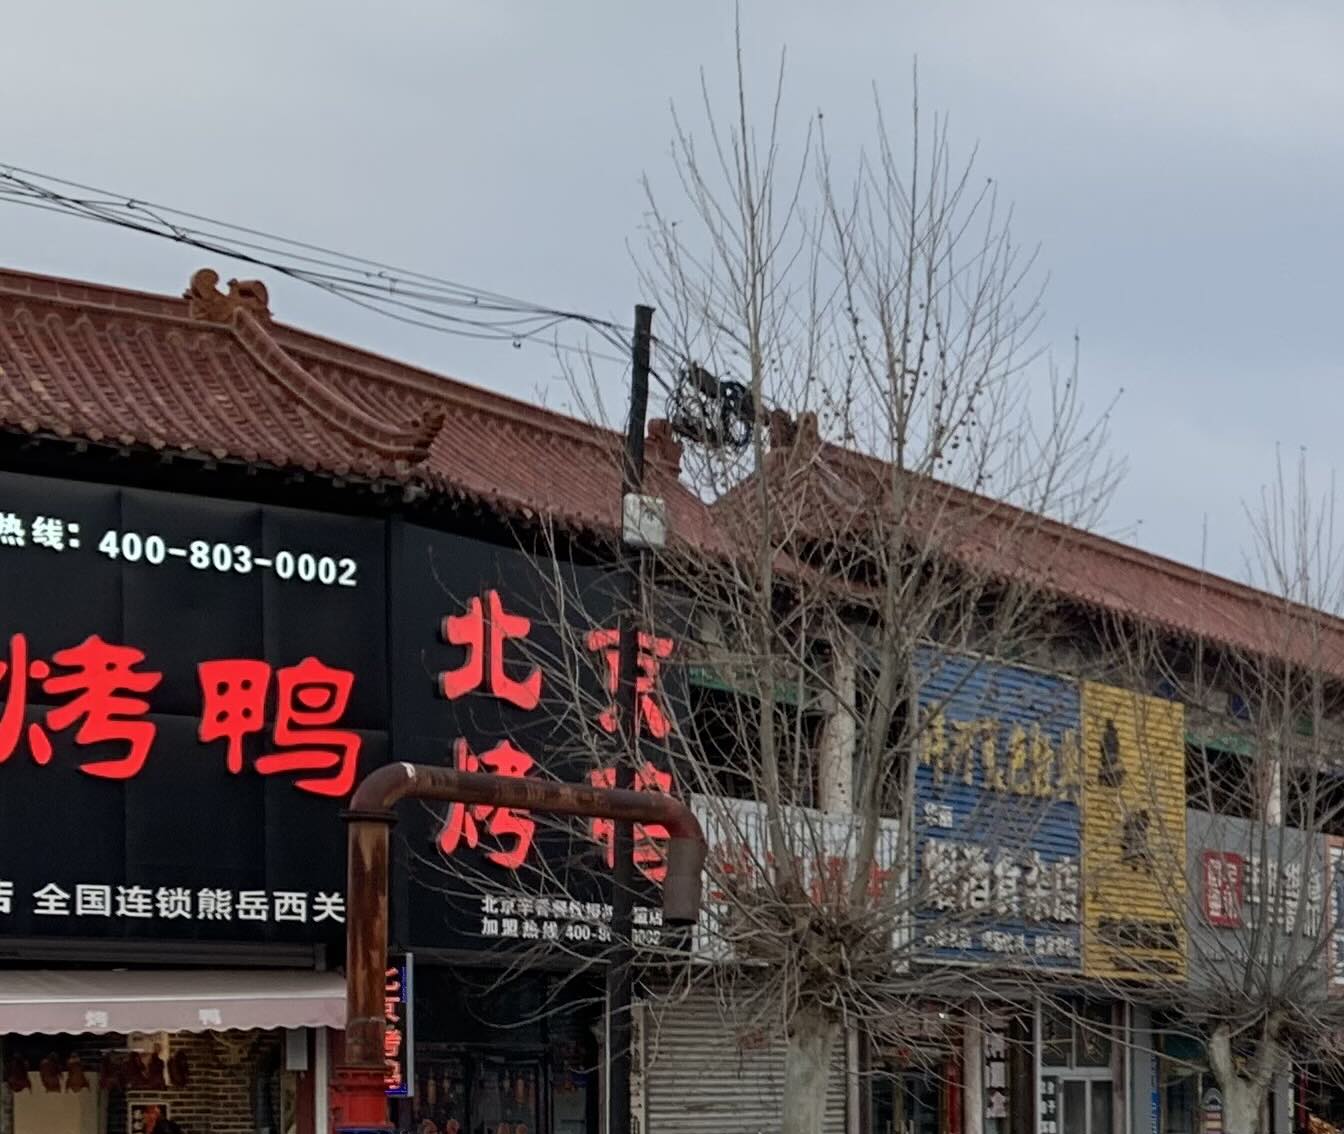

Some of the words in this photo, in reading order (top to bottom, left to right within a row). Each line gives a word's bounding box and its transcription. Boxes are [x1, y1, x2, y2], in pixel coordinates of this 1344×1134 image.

[99, 529, 357, 587] 400-803-0002
[0, 632, 362, 797] 烤鸭
[33, 882, 347, 923] 全国连锁熊岳西关
